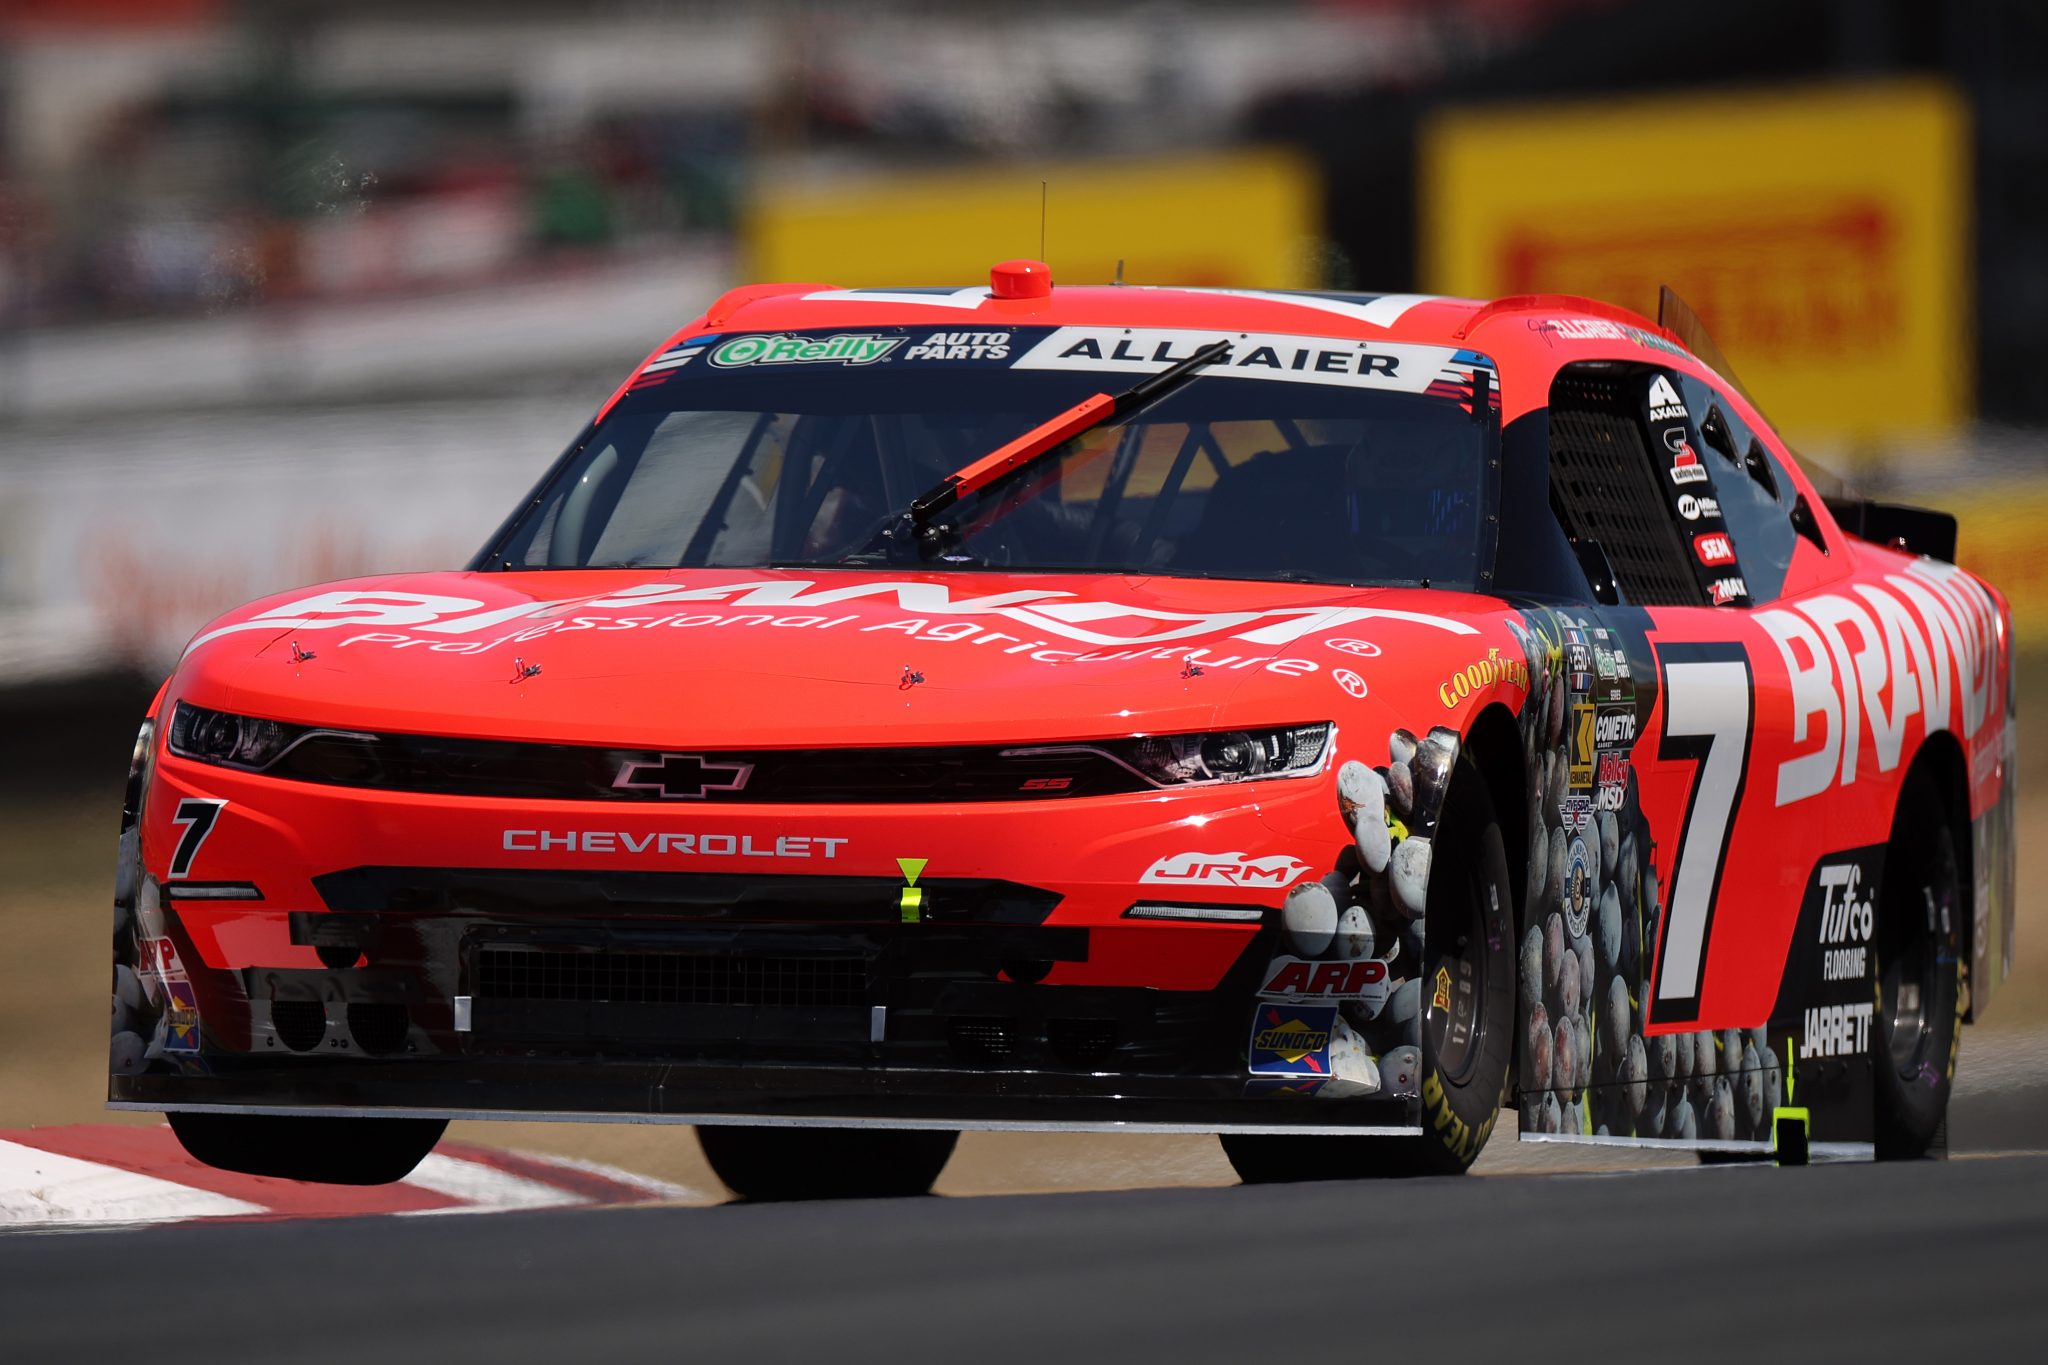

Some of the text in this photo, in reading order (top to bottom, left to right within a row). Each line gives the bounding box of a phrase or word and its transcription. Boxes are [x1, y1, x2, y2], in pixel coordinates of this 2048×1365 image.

[710, 334, 902, 368] O'Reilly
[904, 345, 1011, 361] PARTS
[922, 332, 1011, 346] AUTO
[1650, 404, 1689, 422] AXALTA
[1701, 537, 1732, 561] SEM
[338, 611, 861, 655] Professional
[861, 617, 1321, 676] Agriculture
[1572, 646, 1588, 671] 250
[1596, 713, 1636, 742] COMETIC
[1018, 777, 1073, 791] SS
[1600, 752, 1630, 791] Holley
[1597, 786, 1625, 811] MSD
[168, 798, 229, 878] 7
[503, 829, 848, 859] CHEVROLET
[1648, 642, 1754, 1023] 7
[1154, 858, 1290, 887] JRM
[1819, 863, 1873, 944] Tufco
[1264, 961, 1387, 995] ARP
[1823, 947, 1866, 981] FLOORING
[1256, 1030, 1328, 1051] SUNOCO
[1800, 1002, 1873, 1059] JARRETT
